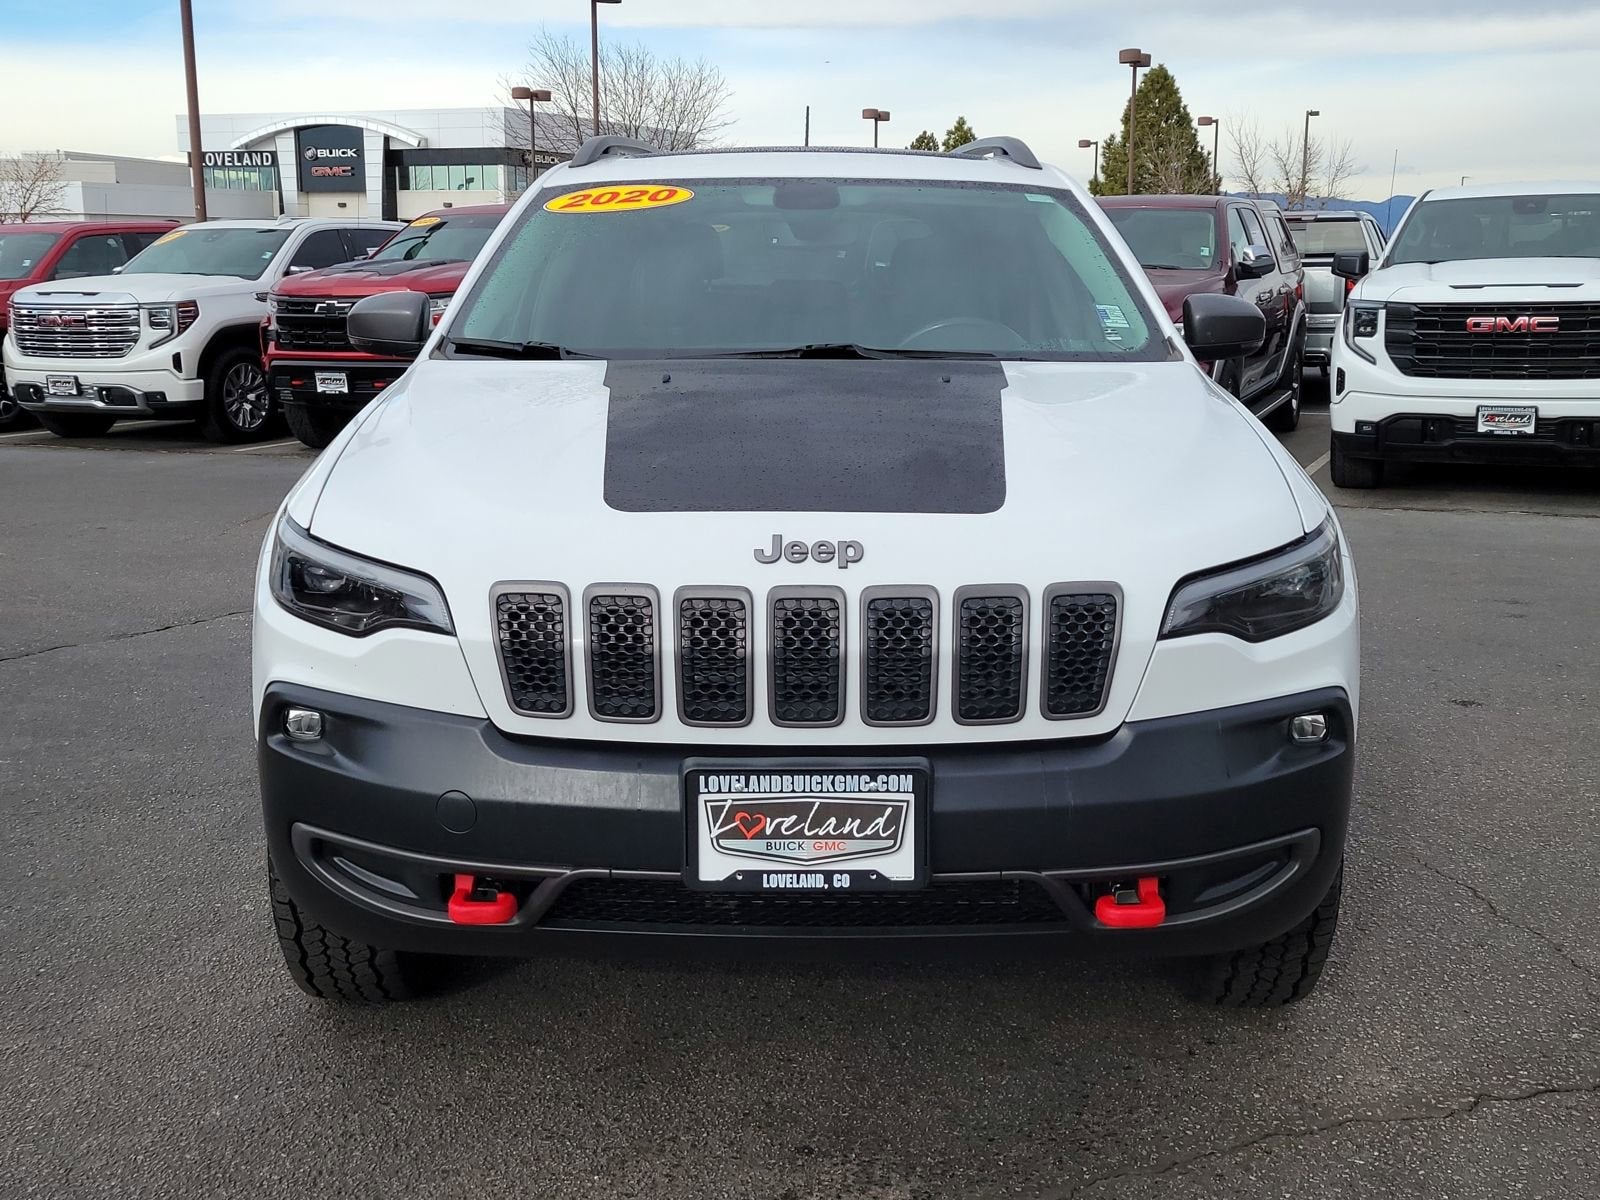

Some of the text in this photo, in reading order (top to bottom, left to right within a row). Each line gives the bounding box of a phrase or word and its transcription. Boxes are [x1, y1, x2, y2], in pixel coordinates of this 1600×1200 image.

[203, 152, 272, 167] OVELAND
[317, 148, 358, 158] BUICK
[534, 154, 560, 164] BUICK
[311, 166, 354, 177] GMC
[559, 189, 678, 209] 2020
[37, 315, 86, 327] GMC
[1466, 316, 1560, 333] GMC
[754, 534, 864, 569] Jeep
[699, 774, 913, 793] LOVELANDBUICKGMC.COM
[766, 841, 847, 851] BUICK GMC
[762, 874, 850, 889] LOVELAND, CO
